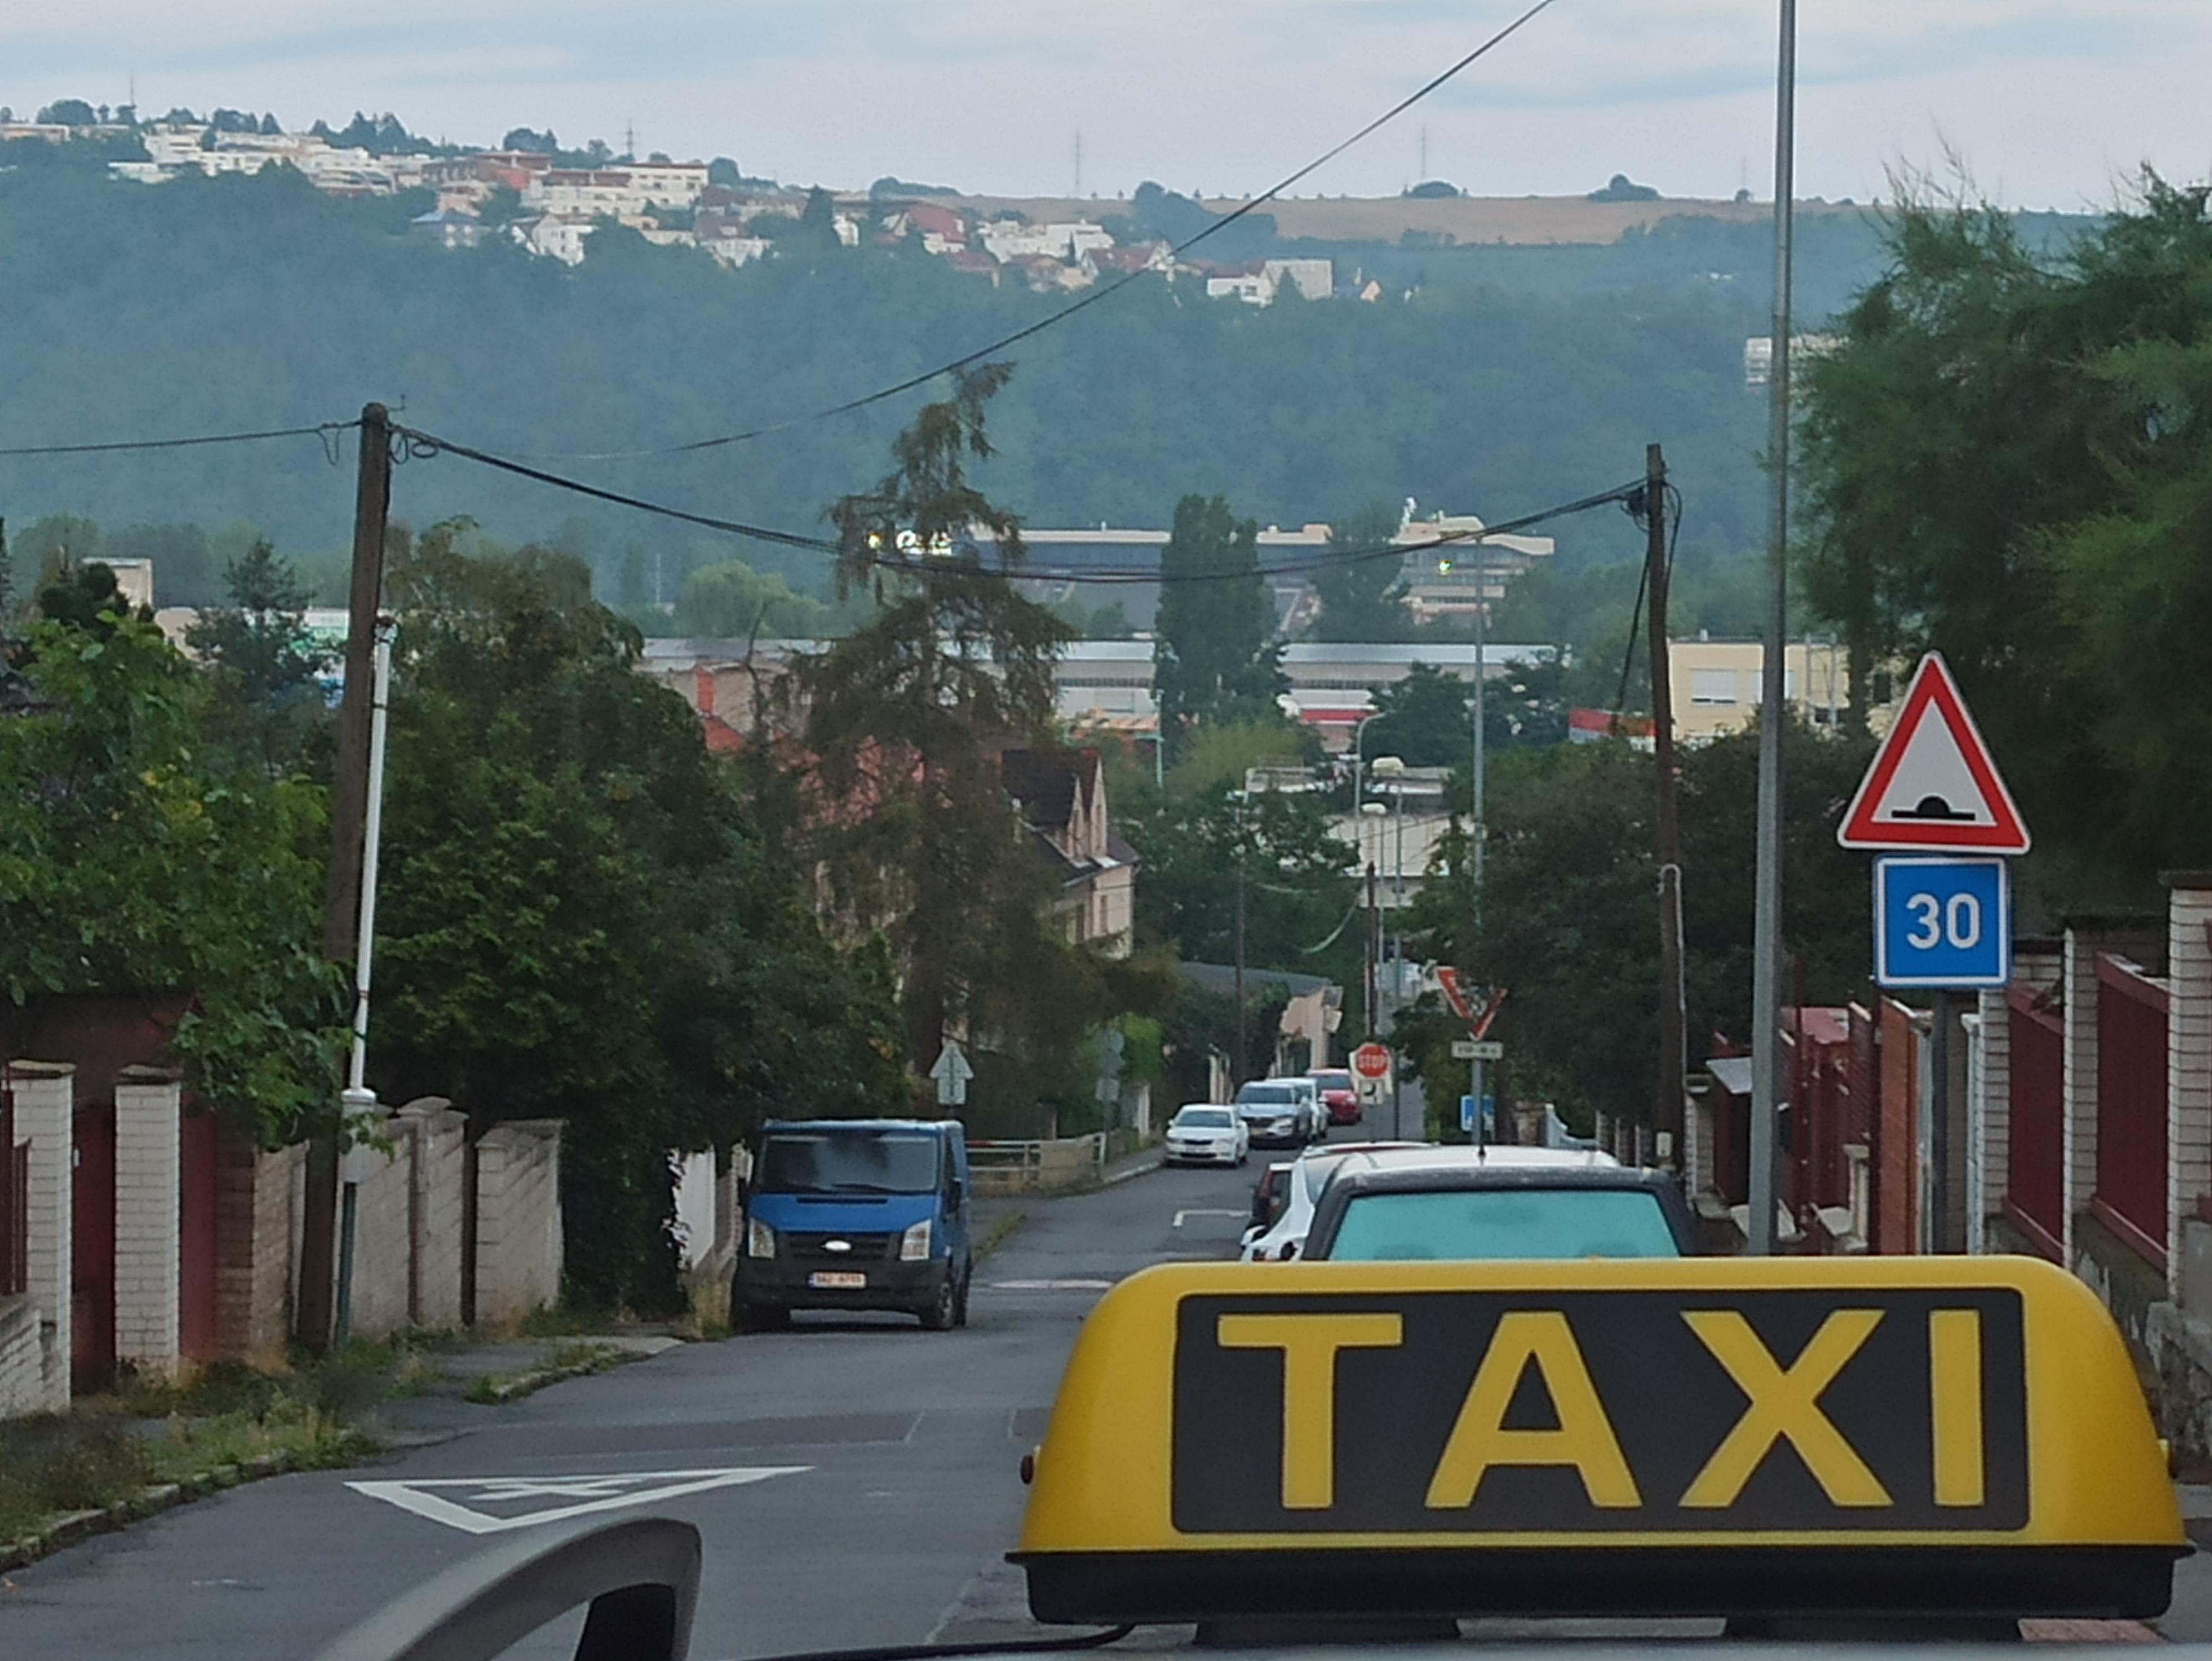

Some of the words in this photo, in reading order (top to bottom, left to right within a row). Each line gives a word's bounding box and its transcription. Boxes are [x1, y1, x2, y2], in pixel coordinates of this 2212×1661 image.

[1906, 893, 1981, 949] 30
[1358, 1055, 1386, 1069] STOP
[1218, 1308, 1985, 1509] TAXI
